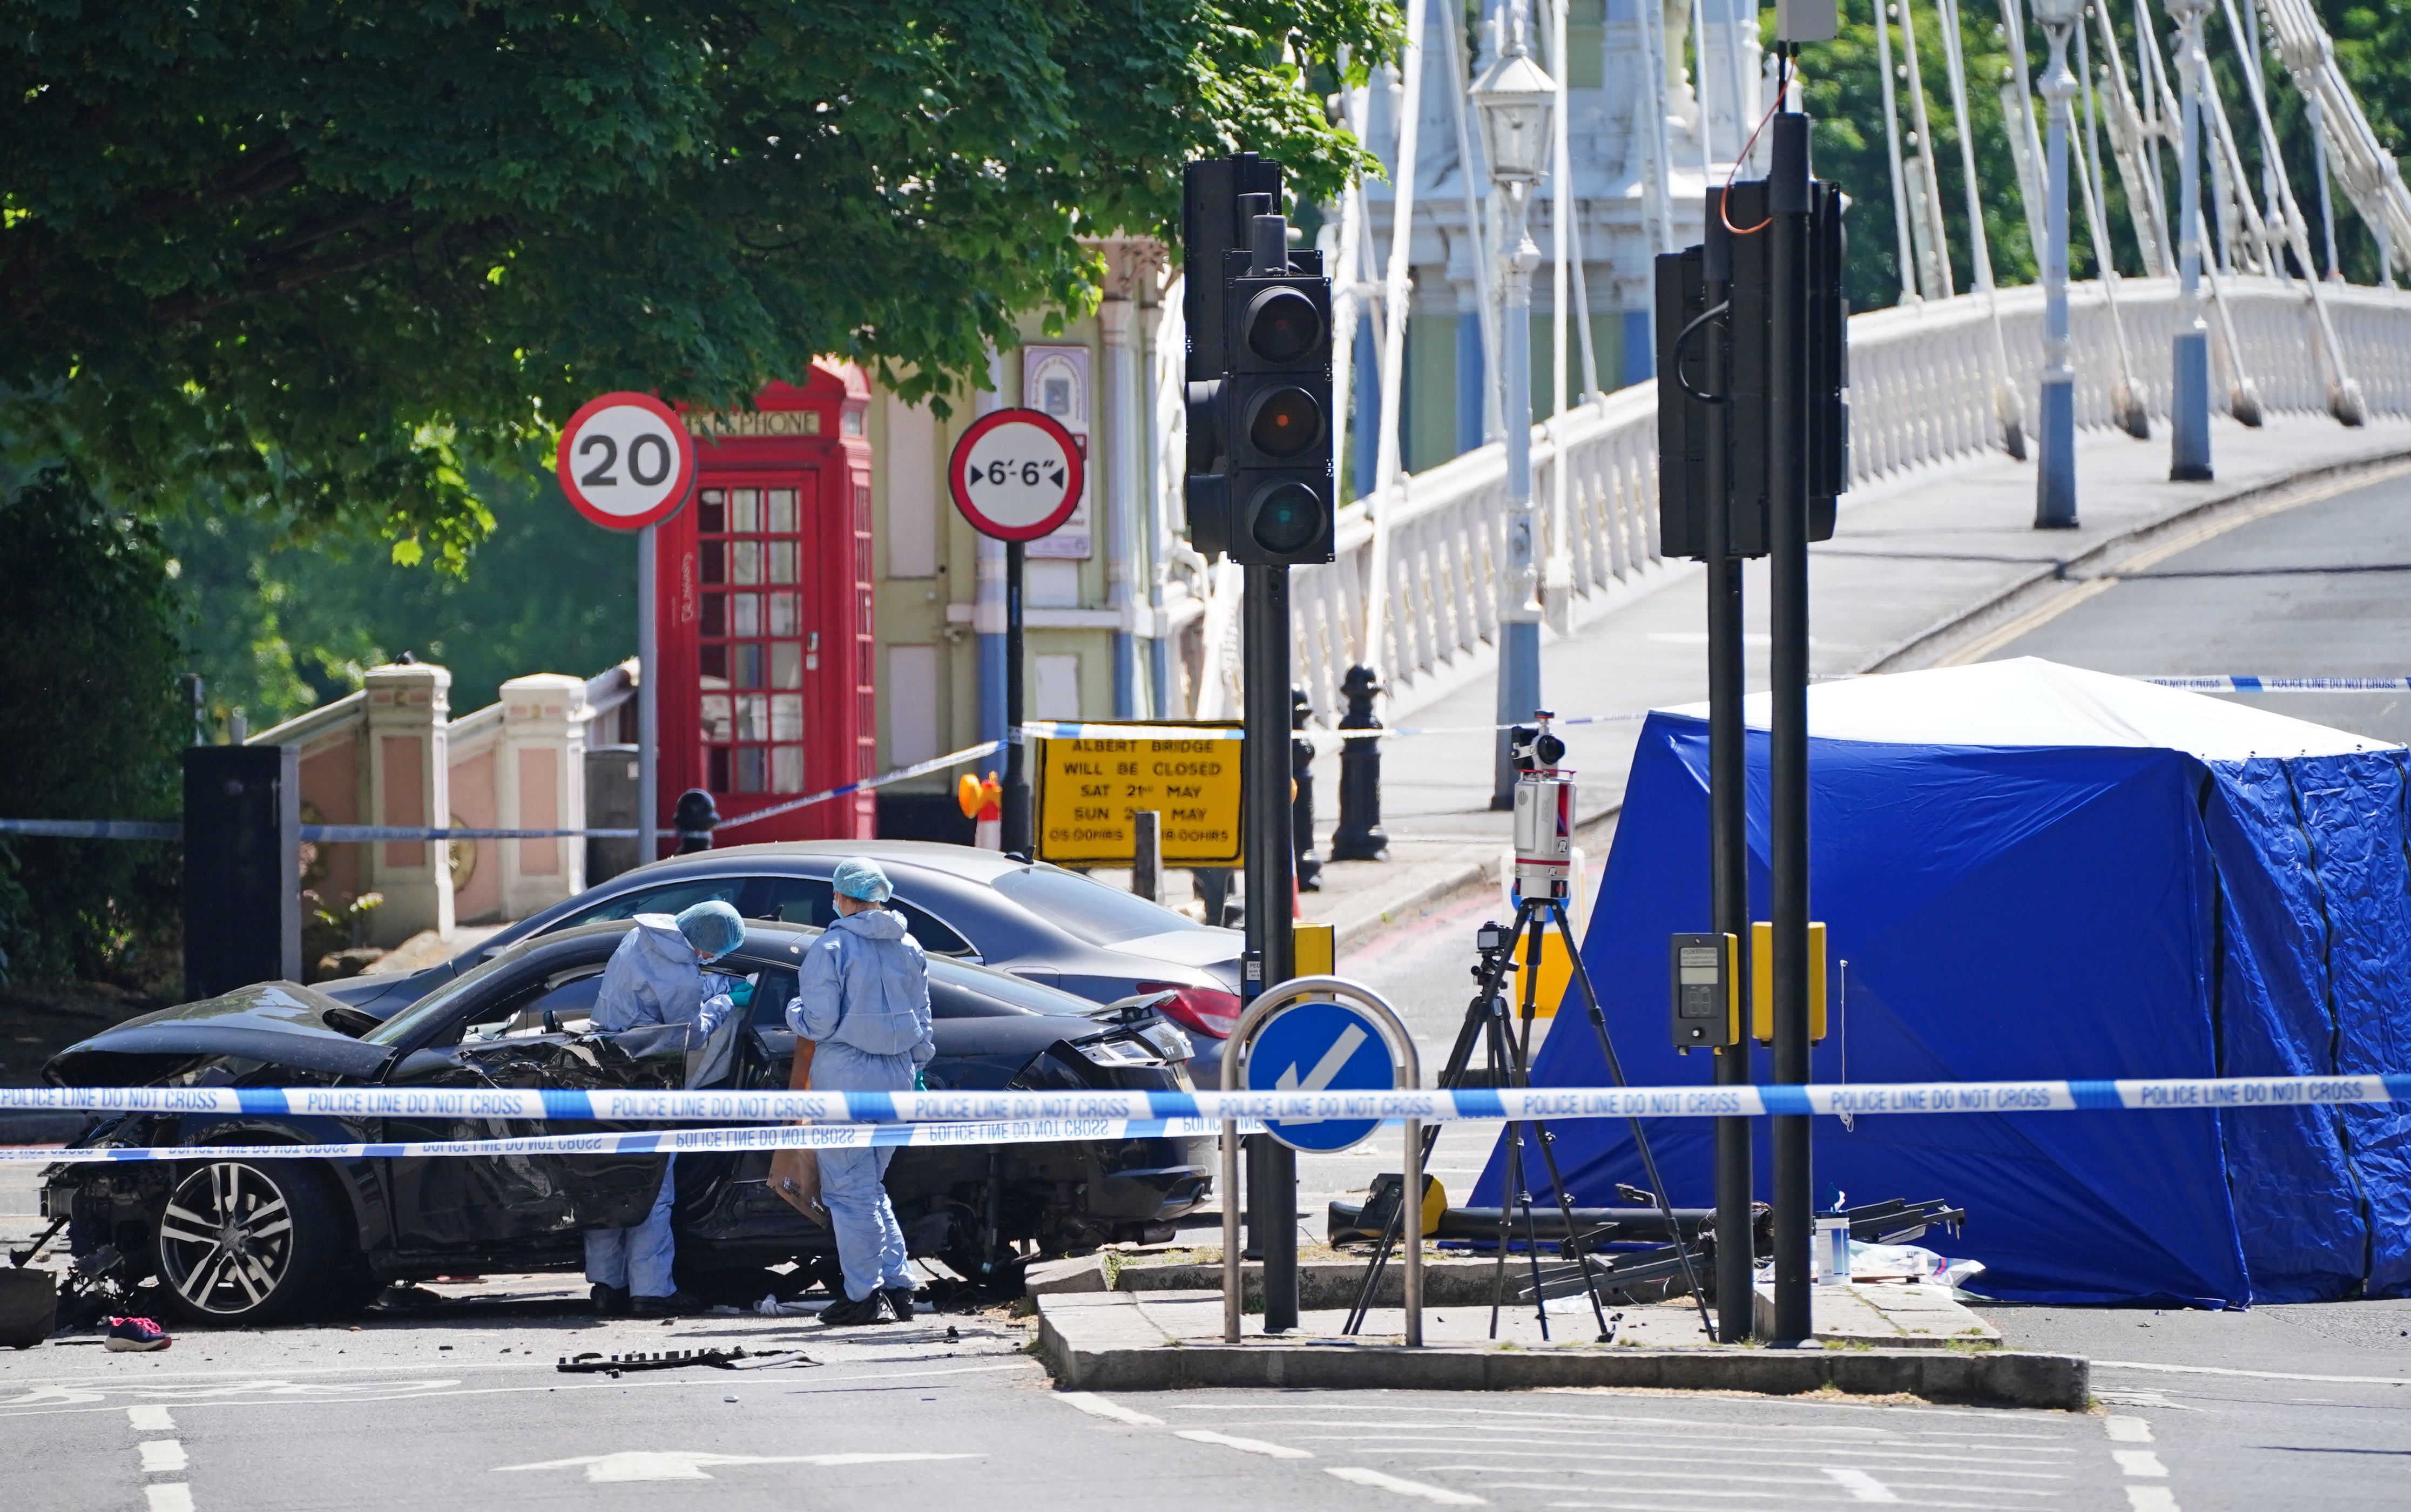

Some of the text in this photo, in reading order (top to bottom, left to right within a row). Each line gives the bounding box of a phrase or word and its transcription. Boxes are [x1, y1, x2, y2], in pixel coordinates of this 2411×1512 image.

[579, 434, 671, 487] 20
[2272, 678, 2396, 689] POLICE LINE DO NOT CROSS
[1071, 739, 1214, 753] ALBERT BRIDGE
[1064, 762, 1221, 776] WILL BE CLOSED
[1080, 785, 1111, 797] SAT
[1166, 785, 1202, 798] MAY
[1074, 807, 1109, 821] SUN
[1171, 808, 1207, 822] MAY
[1, 1087, 218, 1110] POLICE LINE DO NOT CROSS
[308, 1092, 523, 1115] POLICE LINE DO NOT CROSS
[1524, 1092, 1740, 1115] POLICE LINE DO NOT CROSS
[1832, 1088, 2050, 1111] POLICE LINE DO NOT CROSS
[2142, 1082, 2362, 1106] POLICE LINE DO NOT CROSS
[611, 1096, 826, 1118] POLICE LINE DO NOT CROSS
[915, 1097, 1130, 1118] POLICE LINE DO NOT CROSS
[1219, 1096, 1434, 1118] POLICE LINE DO NOT CROSS
